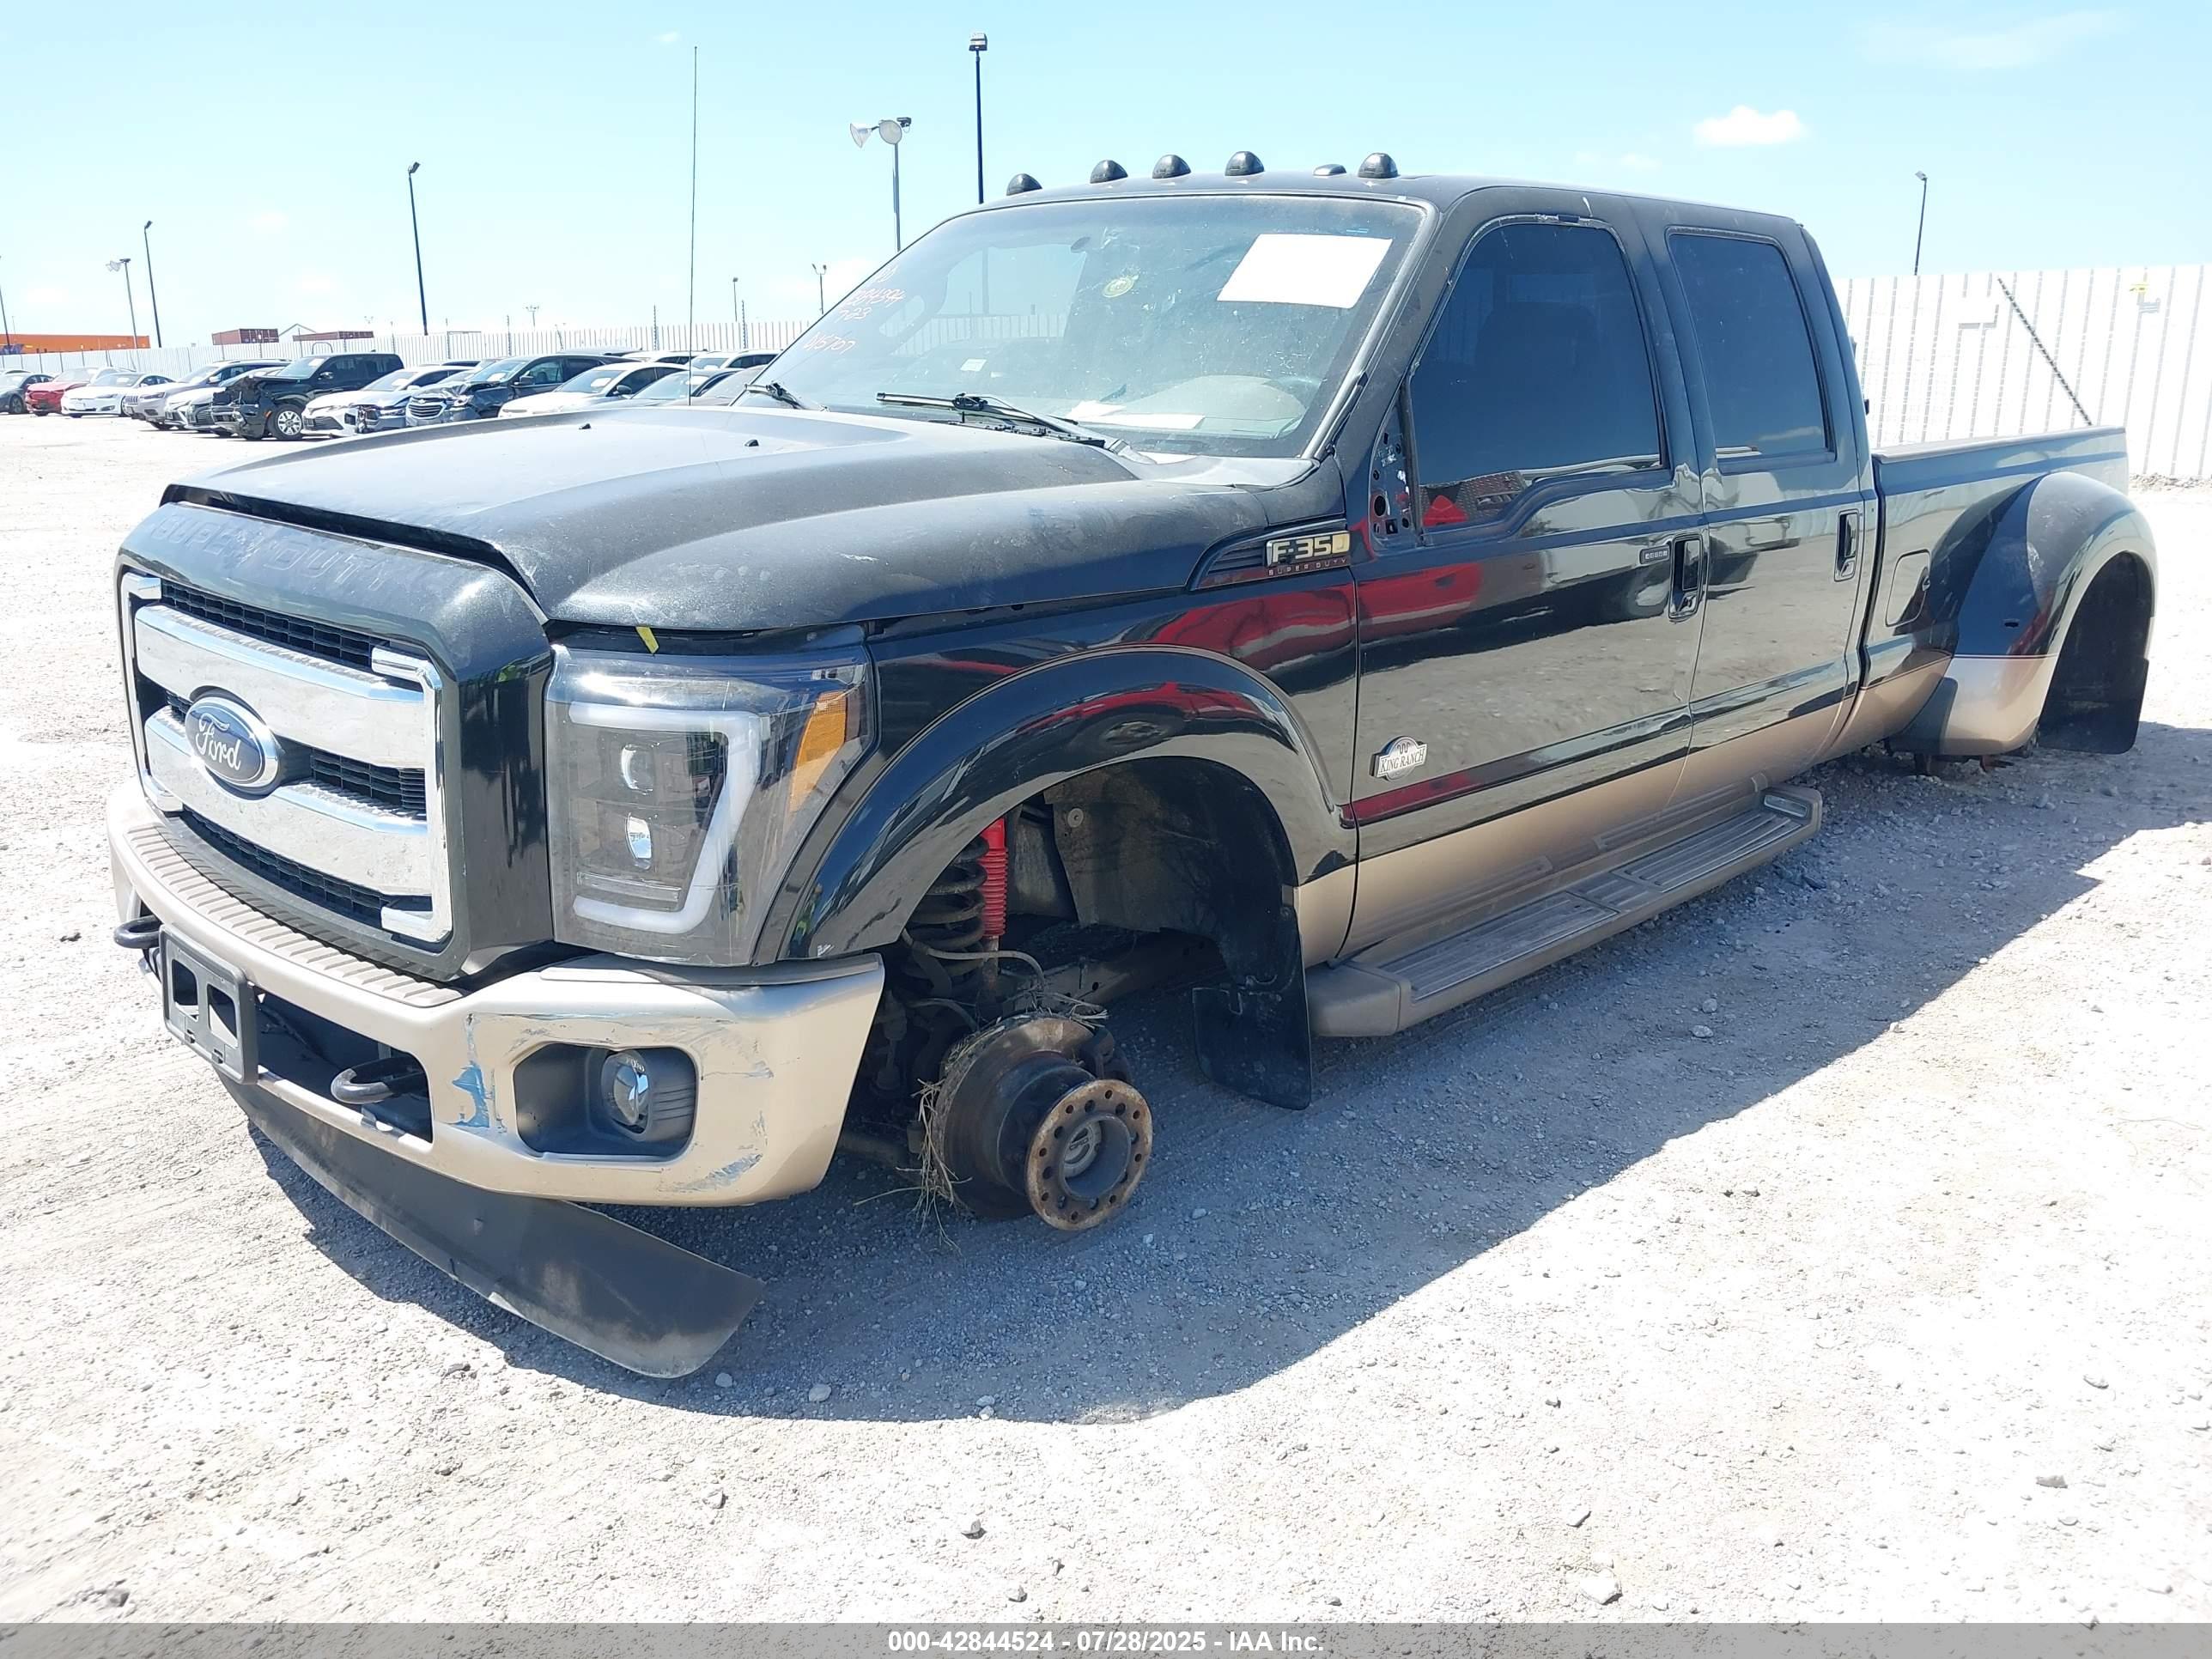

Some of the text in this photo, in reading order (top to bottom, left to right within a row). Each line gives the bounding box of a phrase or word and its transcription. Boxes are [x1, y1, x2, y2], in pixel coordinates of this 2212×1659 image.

[1268, 557, 1347, 576] SUPER DUTY
[195, 712, 241, 770] Ford
[1380, 749, 1425, 773] KING RANCH
